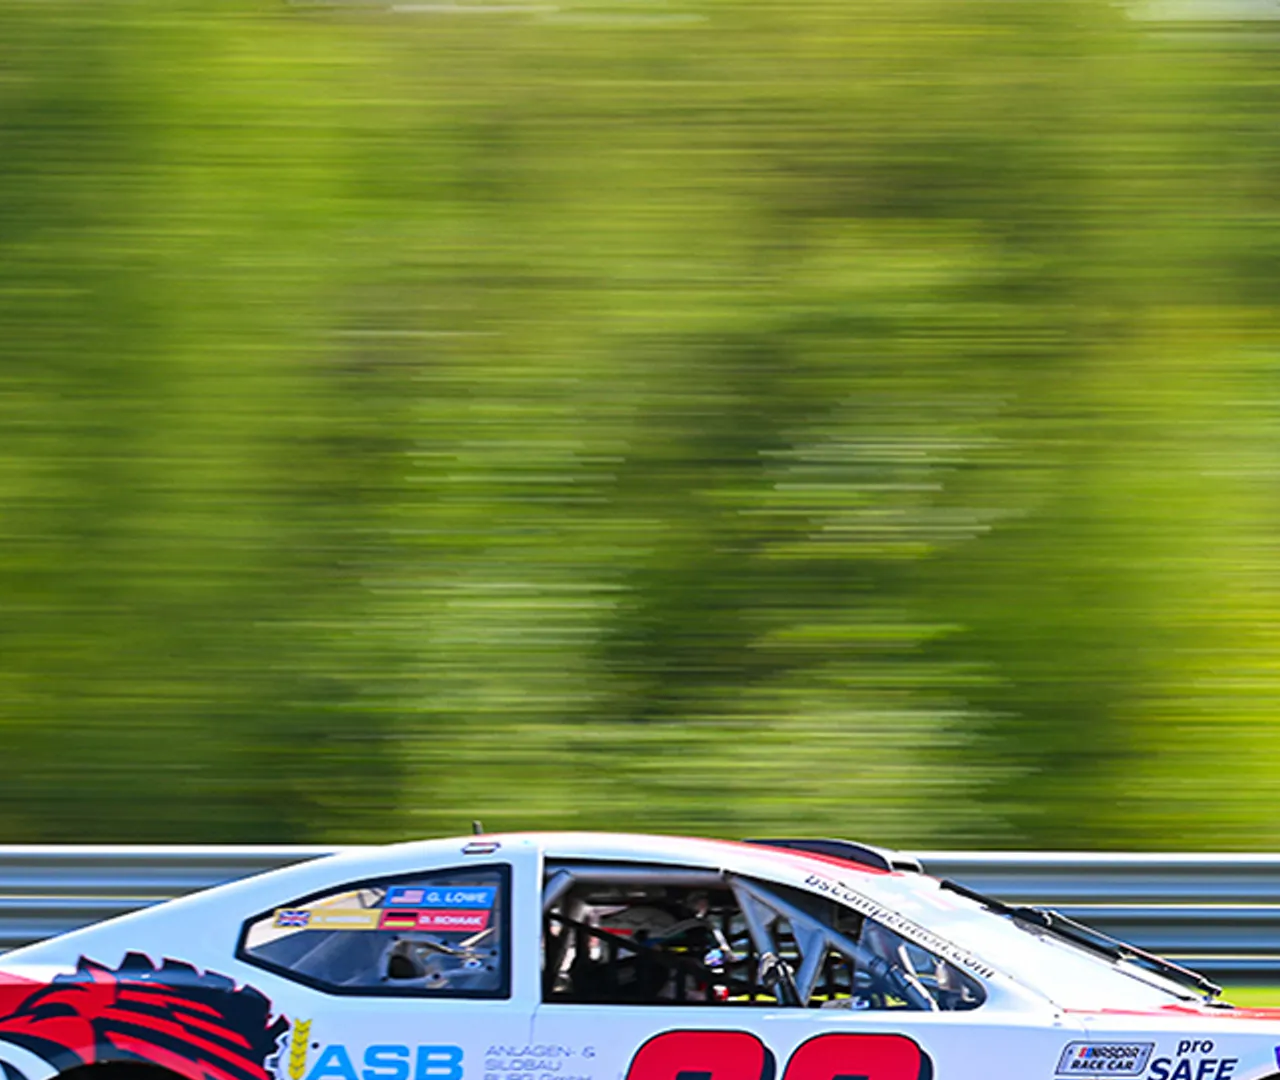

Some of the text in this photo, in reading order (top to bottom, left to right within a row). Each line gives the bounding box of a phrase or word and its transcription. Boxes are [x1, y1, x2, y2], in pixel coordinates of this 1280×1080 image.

[444, 891, 488, 904] LOWE
[1090, 1047, 1140, 1058] NASCAR
[1177, 1040, 1214, 1056] pro
[1071, 1059, 1133, 1070] RACE CAR
